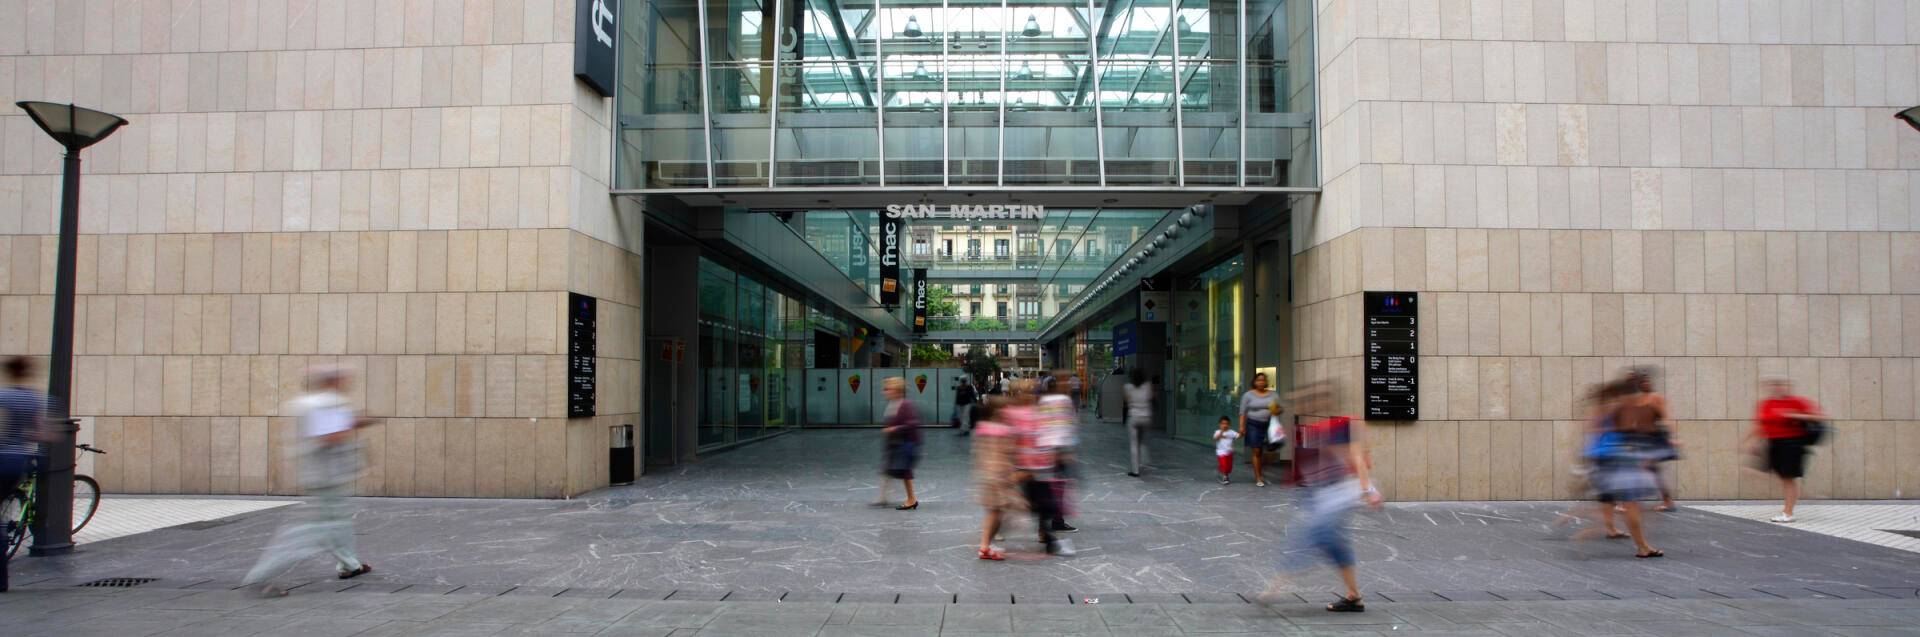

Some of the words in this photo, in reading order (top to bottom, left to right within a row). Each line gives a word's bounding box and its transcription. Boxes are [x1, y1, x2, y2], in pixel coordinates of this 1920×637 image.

[886, 204, 936, 219] SAN
[950, 204, 1045, 219] MARTIN
[882, 222, 897, 267] fnac
[915, 280, 926, 309] fnac
[1410, 317, 1415, 325] 3
[1410, 356, 1415, 364] 0
[1407, 407, 1415, 415] -3
